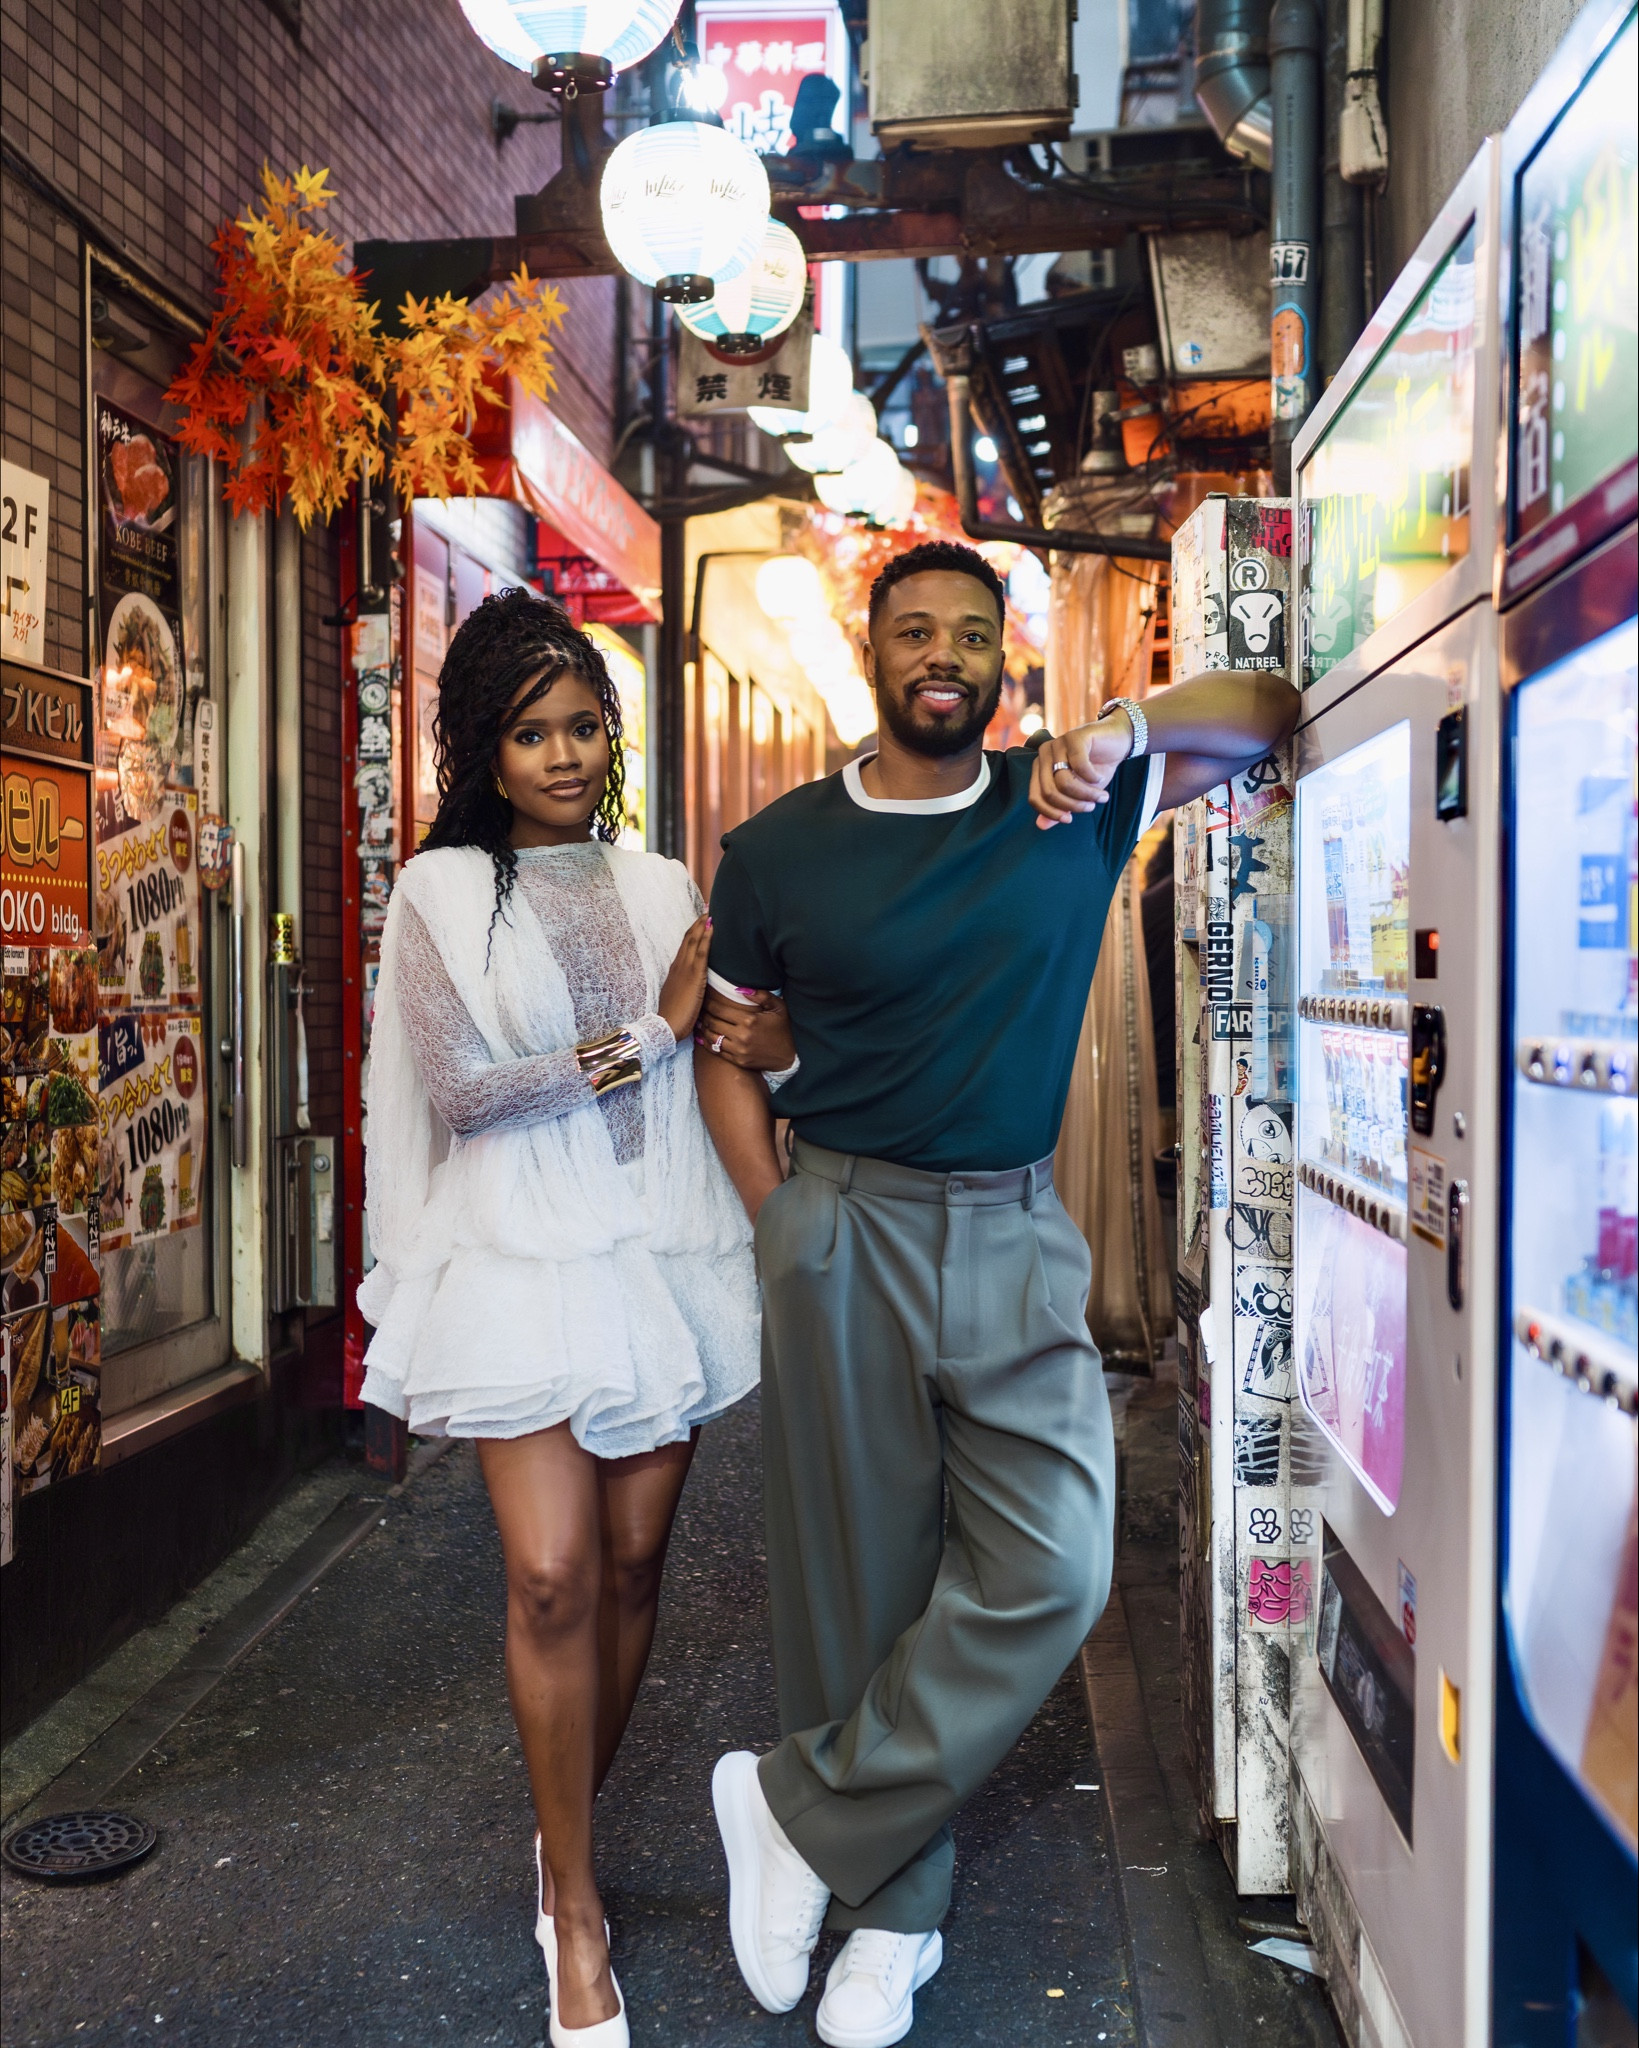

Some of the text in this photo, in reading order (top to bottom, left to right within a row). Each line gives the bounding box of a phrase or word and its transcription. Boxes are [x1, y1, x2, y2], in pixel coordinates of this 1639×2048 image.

[696, 373, 792, 403] 禁煙
[2, 496, 38, 549] 2F
[115, 522, 168, 563] KOBE BEEF
[12, 609, 39, 630] カイダン
[12, 626, 29, 644] スグ!
[1235, 656, 1282, 669] NATREEL
[97, 824, 169, 890] 3つ合わせて
[51, 904, 83, 943] bldg.
[1207, 921, 1234, 1002] GERNO
[99, 1055, 172, 1137] 3つ合わせて
[44, 1224, 55, 1239] 4F
[88, 1212, 98, 1226] 4F
[12, 1333, 24, 1346] Fish
[61, 1387, 78, 1414] 4F
